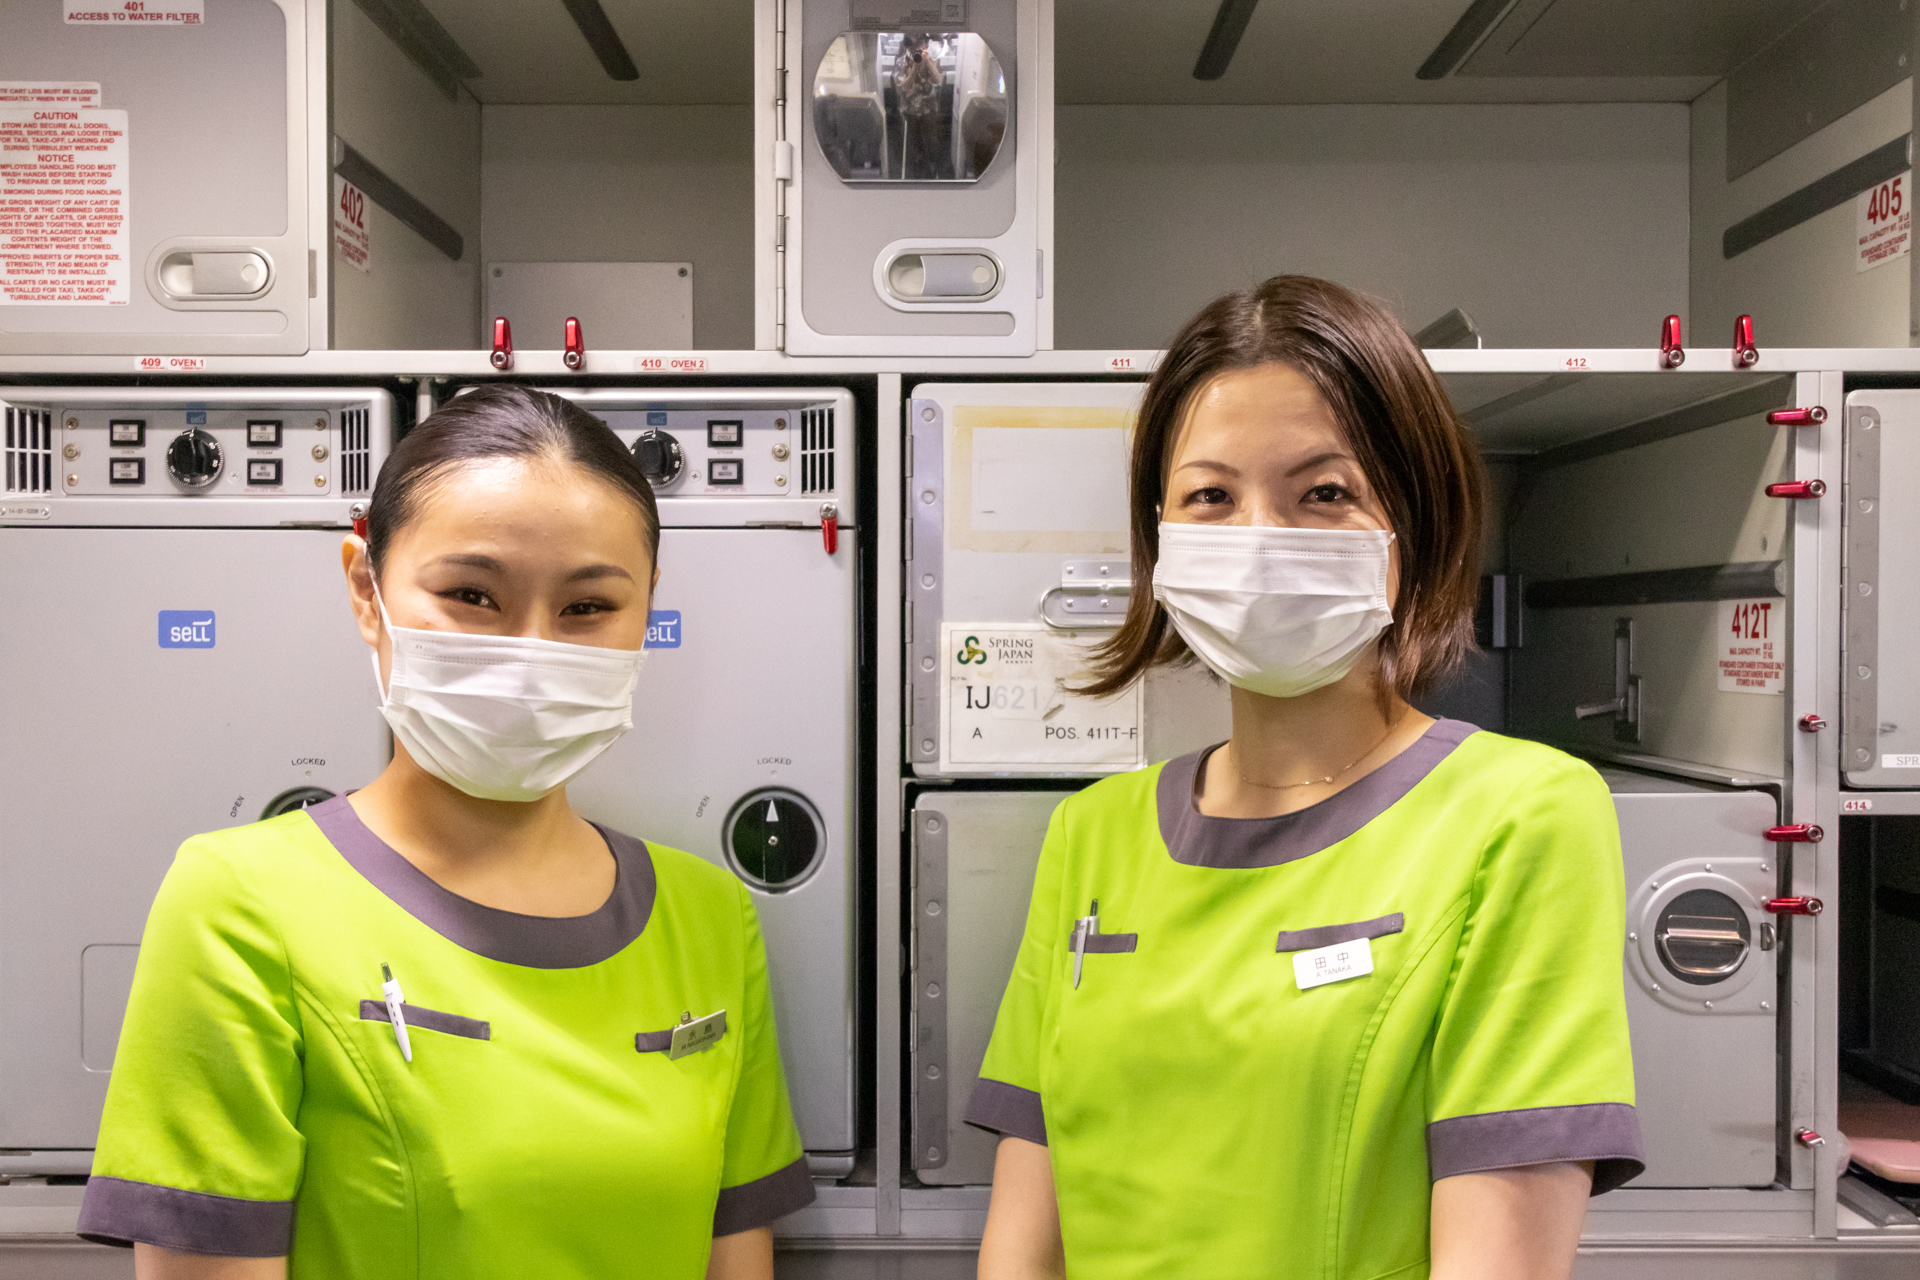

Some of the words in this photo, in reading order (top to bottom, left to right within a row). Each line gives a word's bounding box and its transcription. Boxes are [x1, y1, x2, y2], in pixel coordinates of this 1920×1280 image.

[124, 1, 144, 12] 401
[68, 12, 110, 21] ACCESS
[112, 12, 126, 21] TO
[128, 12, 163, 21] WATER
[166, 12, 200, 22] FILTER
[33, 111, 78, 121] CAUTION
[37, 154, 75, 163] NOTICE
[341, 182, 364, 230] 402
[1867, 178, 1902, 224] 405
[141, 358, 161, 367] 409
[170, 359, 196, 367] OVEN
[641, 359, 662, 368] 410
[1111, 358, 1130, 367] 411
[1566, 358, 1586, 366] 412
[1732, 603, 1771, 639] 412T
[646, 620, 677, 642] ell
[989, 637, 1033, 648] SPRING
[999, 649, 1033, 660] JAPAN
[972, 727, 983, 739] A
[1045, 726, 1080, 739] POS.
[1087, 727, 1137, 739] 411T-F
[291, 758, 326, 766] LOCKED
[757, 757, 792, 765] LOCKED
[1896, 756, 1920, 766] SPR
[230, 796, 244, 818] OPEN
[695, 795, 710, 818] OPEN
[1846, 801, 1866, 810] 414
[1315, 952, 1349, 969] 田中
[1324, 964, 1352, 976] TANAKA
